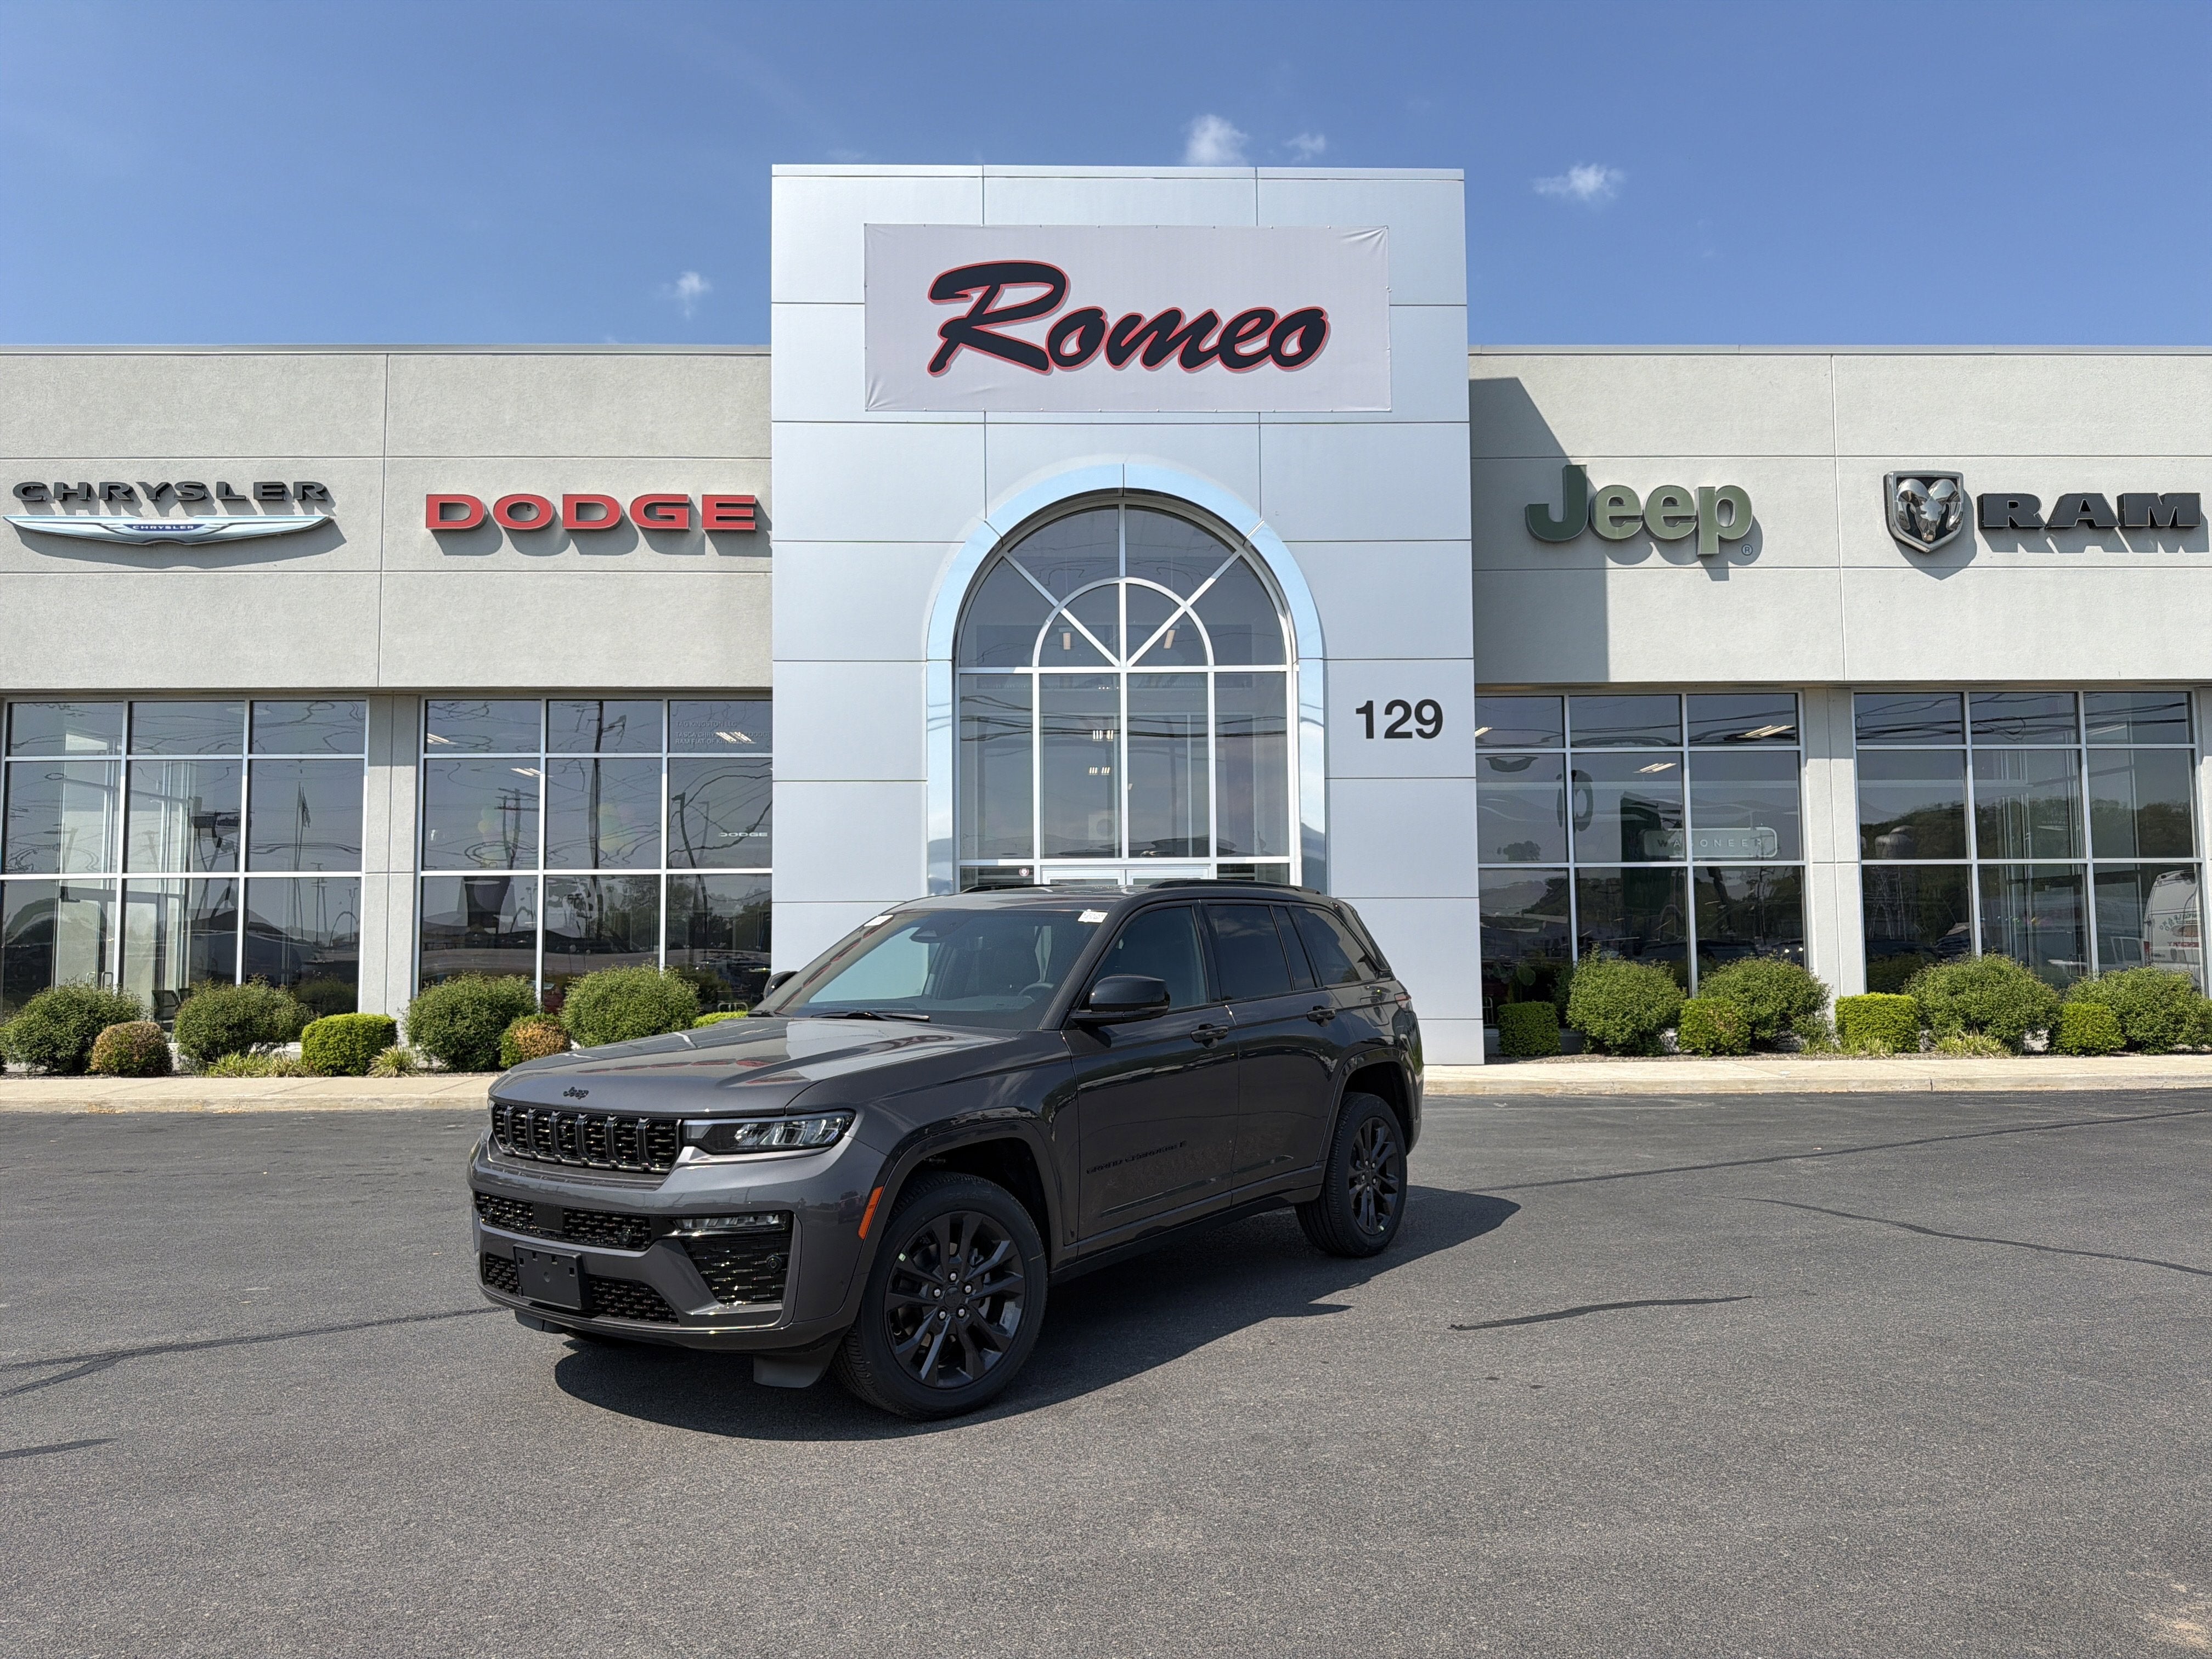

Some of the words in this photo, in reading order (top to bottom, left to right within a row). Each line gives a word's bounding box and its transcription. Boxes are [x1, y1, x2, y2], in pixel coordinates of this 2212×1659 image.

[927, 259, 1330, 375] Romeo
[12, 481, 328, 502] CHRYSLER
[426, 493, 758, 530] DODGE
[1525, 464, 1753, 556] Jeep
[1977, 493, 2202, 529] RAM
[1356, 699, 1443, 739] 129
[1657, 839, 1762, 848] WAONEER
[563, 1087, 589, 1099] Jeep
